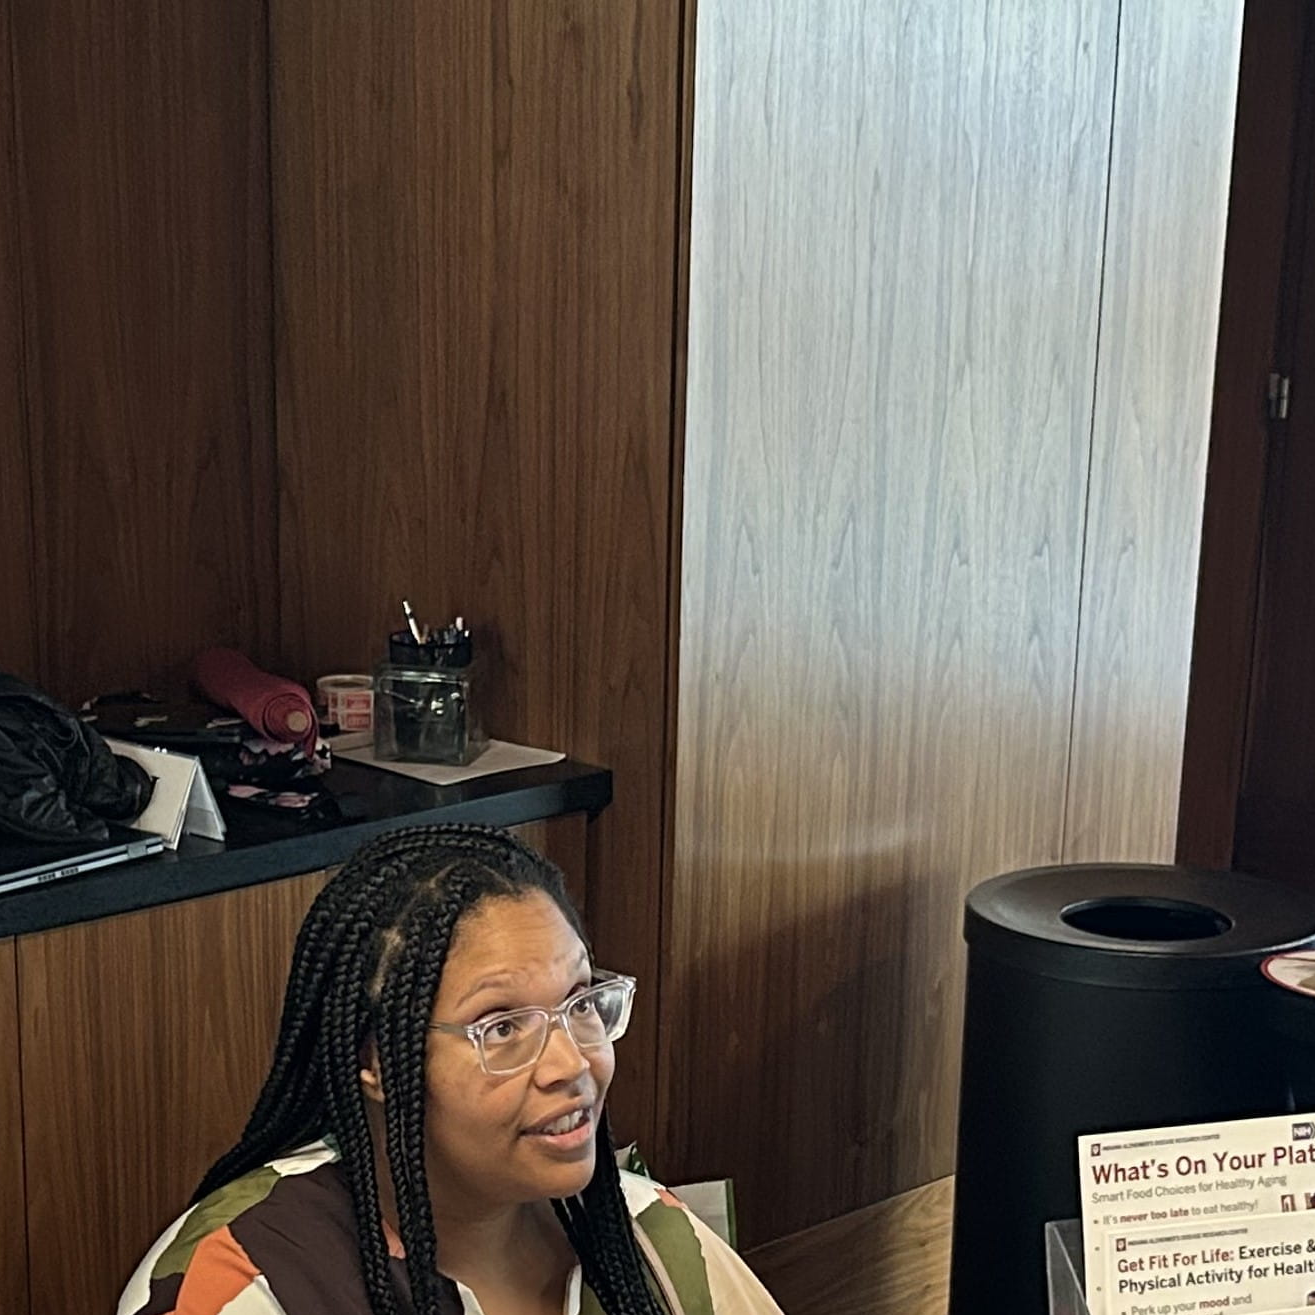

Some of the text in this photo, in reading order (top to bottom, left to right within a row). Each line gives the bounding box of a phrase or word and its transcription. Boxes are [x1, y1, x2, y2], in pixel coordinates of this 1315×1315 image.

[1091, 1158, 1169, 1185] What's
[1175, 1155, 1207, 1176] On
[1212, 1151, 1266, 1172] Your
[1091, 1174, 1287, 1204] Smart Food Choices for Healthy Aging
[1117, 1257, 1145, 1273] Get
[1148, 1254, 1169, 1270] Fit
[1172, 1252, 1198, 1267] For
[1200, 1247, 1234, 1264] Life:
[1238, 1241, 1302, 1260] Exercise
[1118, 1272, 1181, 1295] Physical
[1185, 1267, 1242, 1286] Activity
[1247, 1264, 1270, 1279] for
[1172, 1301, 1196, 1315] your
[1198, 1295, 1230, 1309] mood
[1231, 1292, 1252, 1306] and
